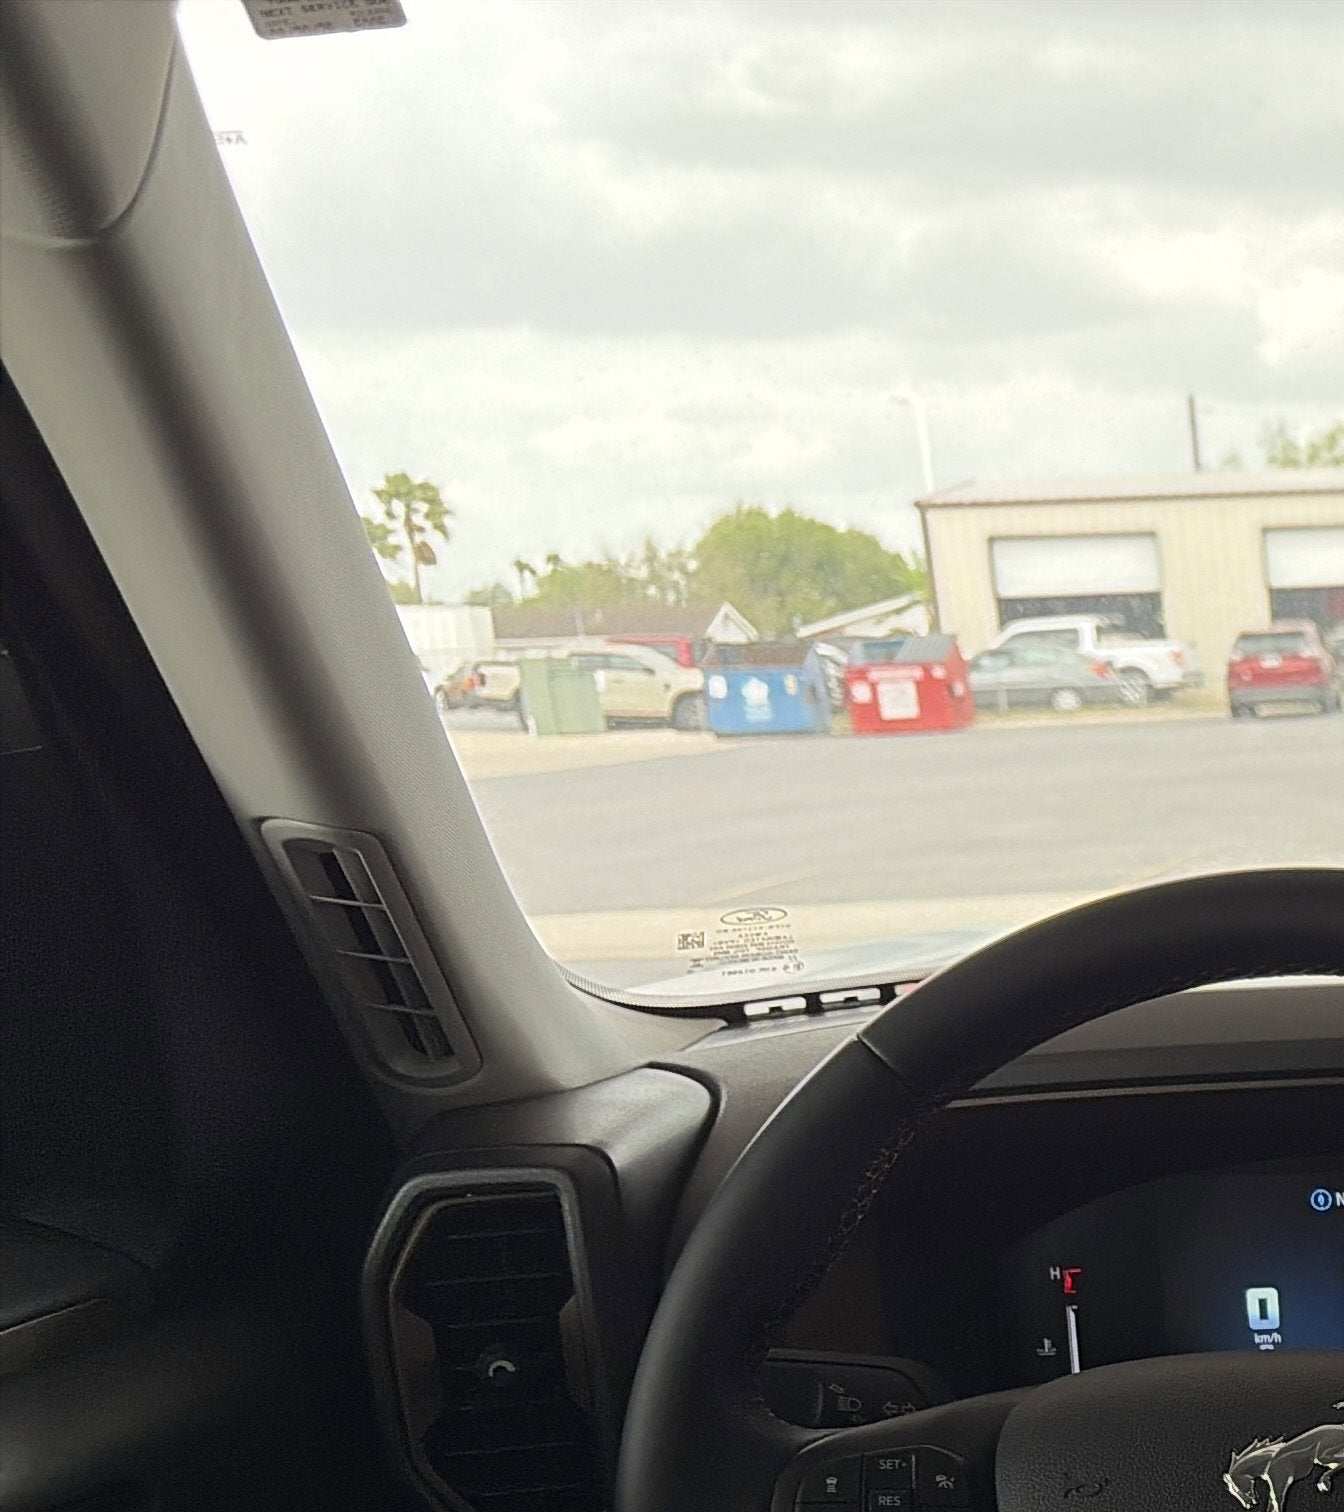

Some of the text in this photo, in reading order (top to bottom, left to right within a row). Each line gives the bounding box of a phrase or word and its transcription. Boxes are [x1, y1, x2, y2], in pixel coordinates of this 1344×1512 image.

[1050, 1267, 1060, 1280] H
[1254, 1332, 1282, 1344] km/h
[878, 1496, 901, 1506] RES
